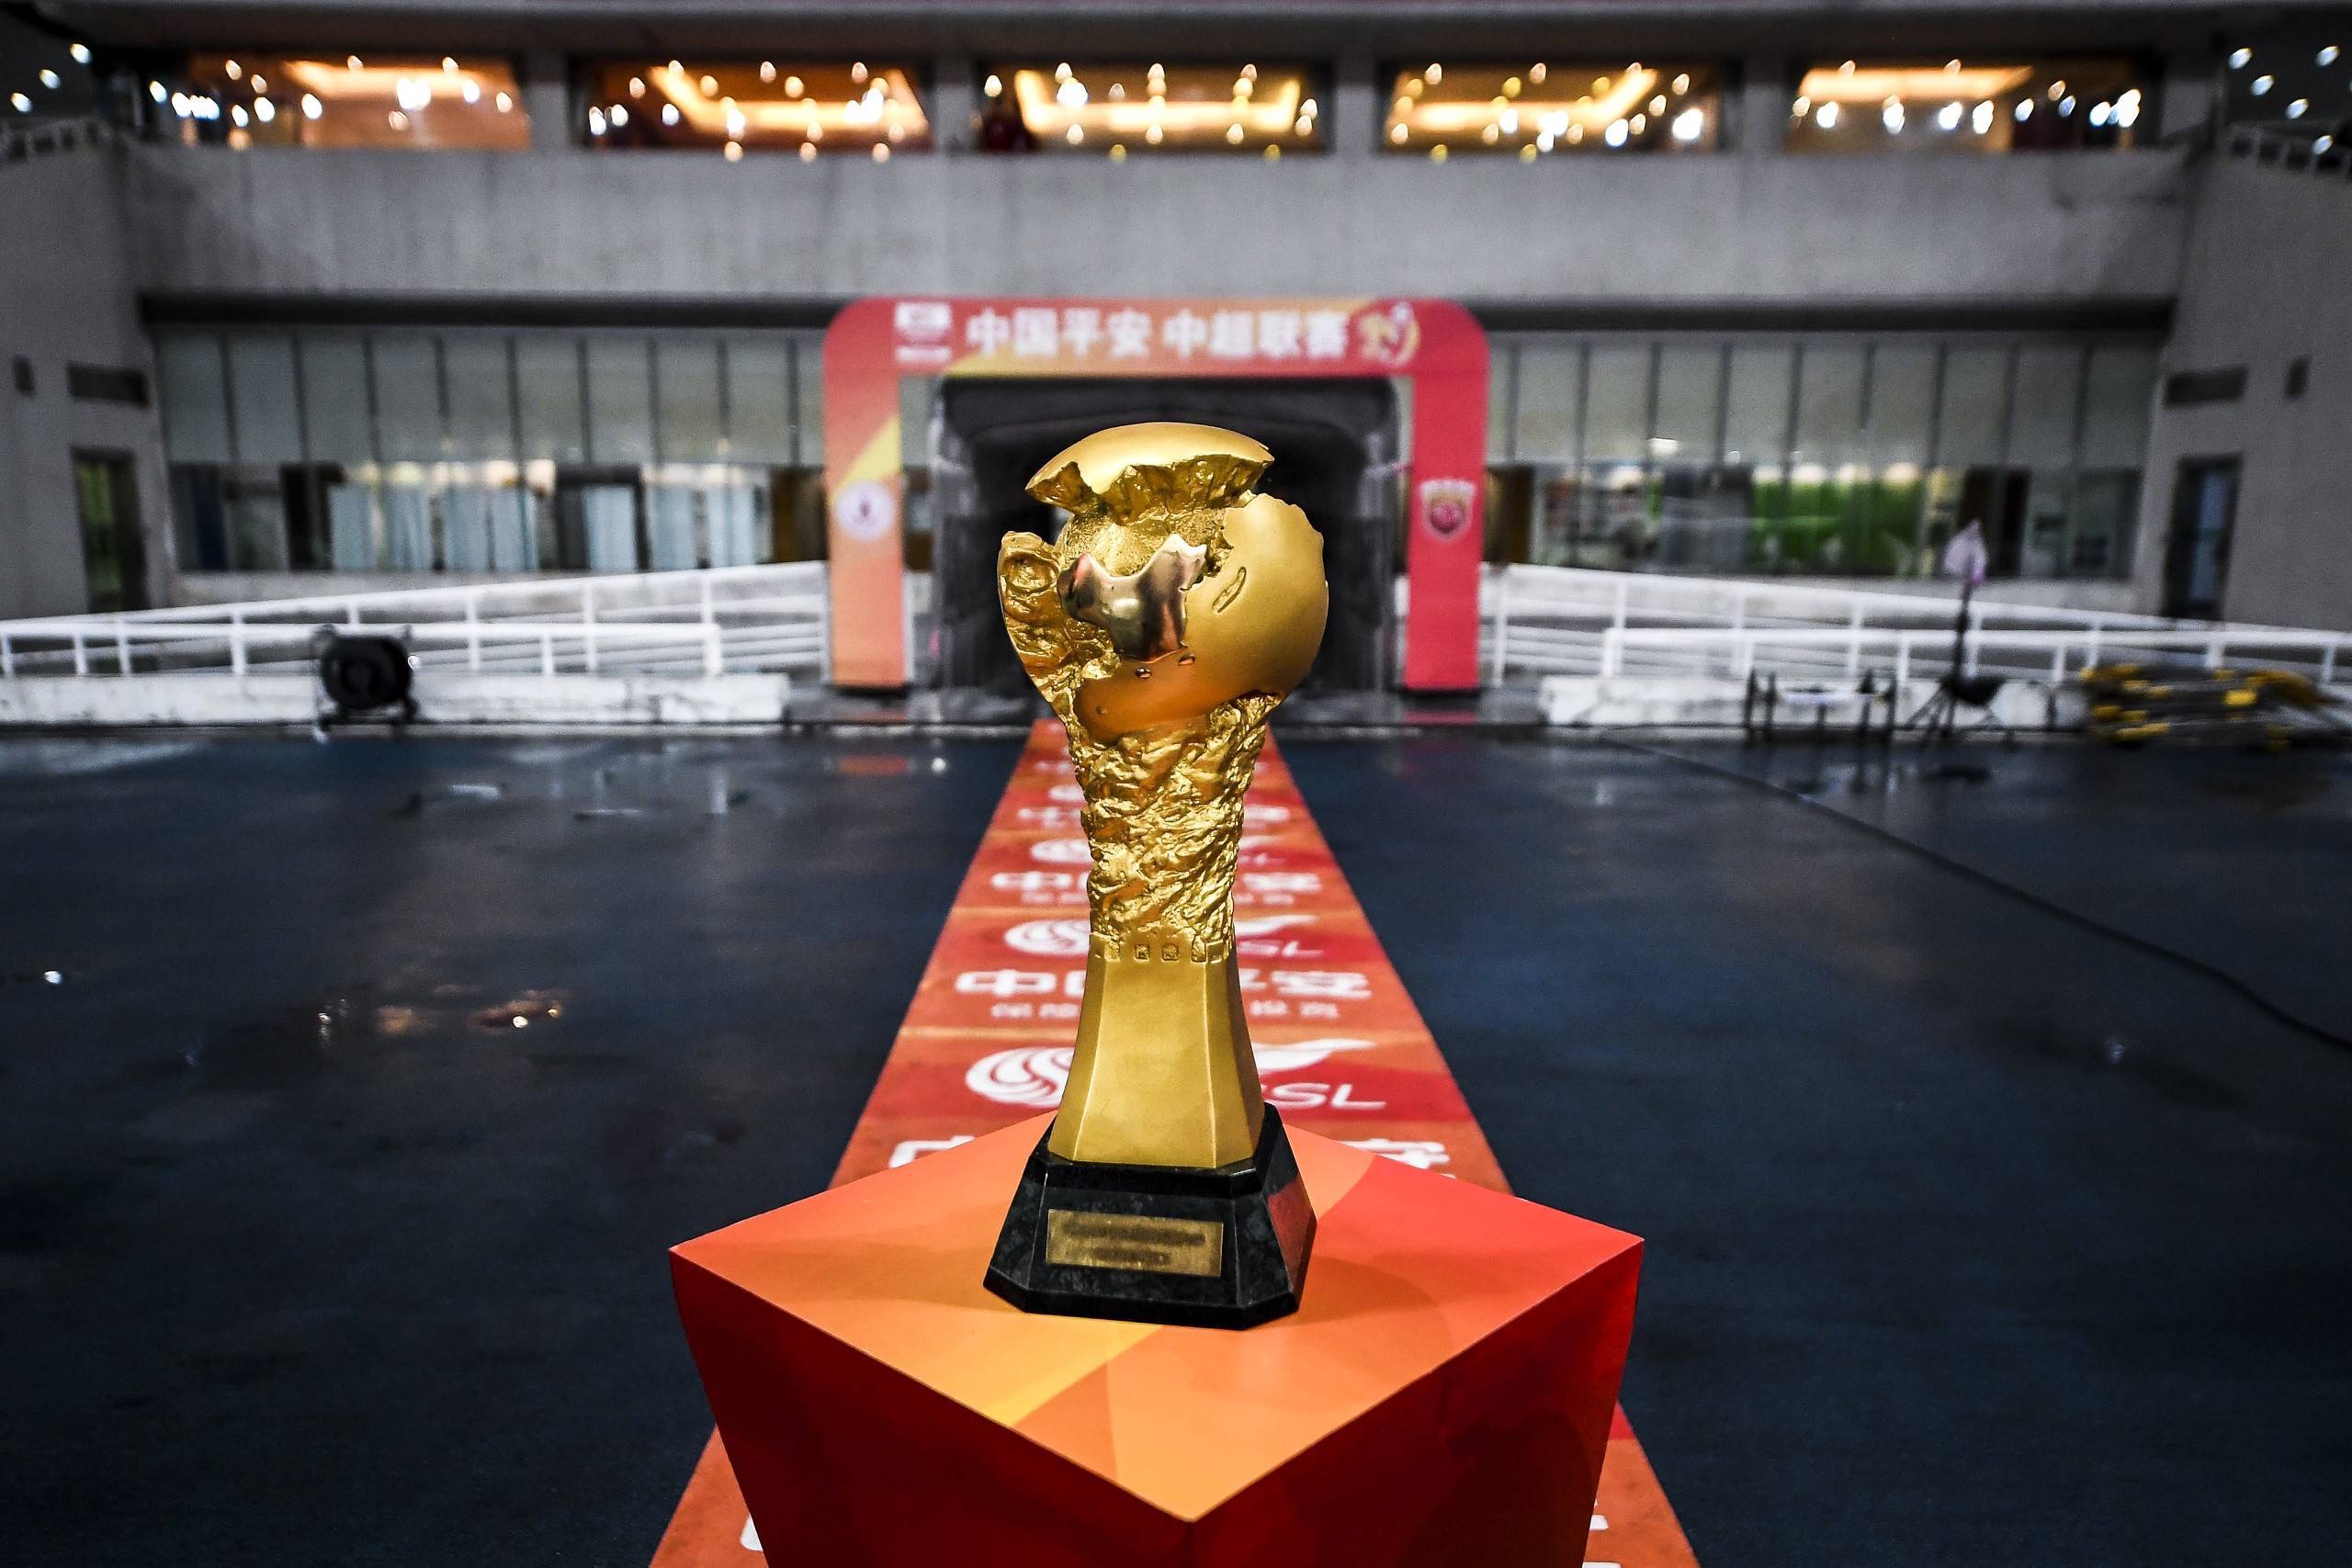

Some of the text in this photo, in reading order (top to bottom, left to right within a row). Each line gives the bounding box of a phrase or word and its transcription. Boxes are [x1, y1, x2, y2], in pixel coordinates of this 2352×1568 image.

[967, 307, 1349, 359] 中国平安 中超联赛
[1261, 1082, 1387, 1111] SL
